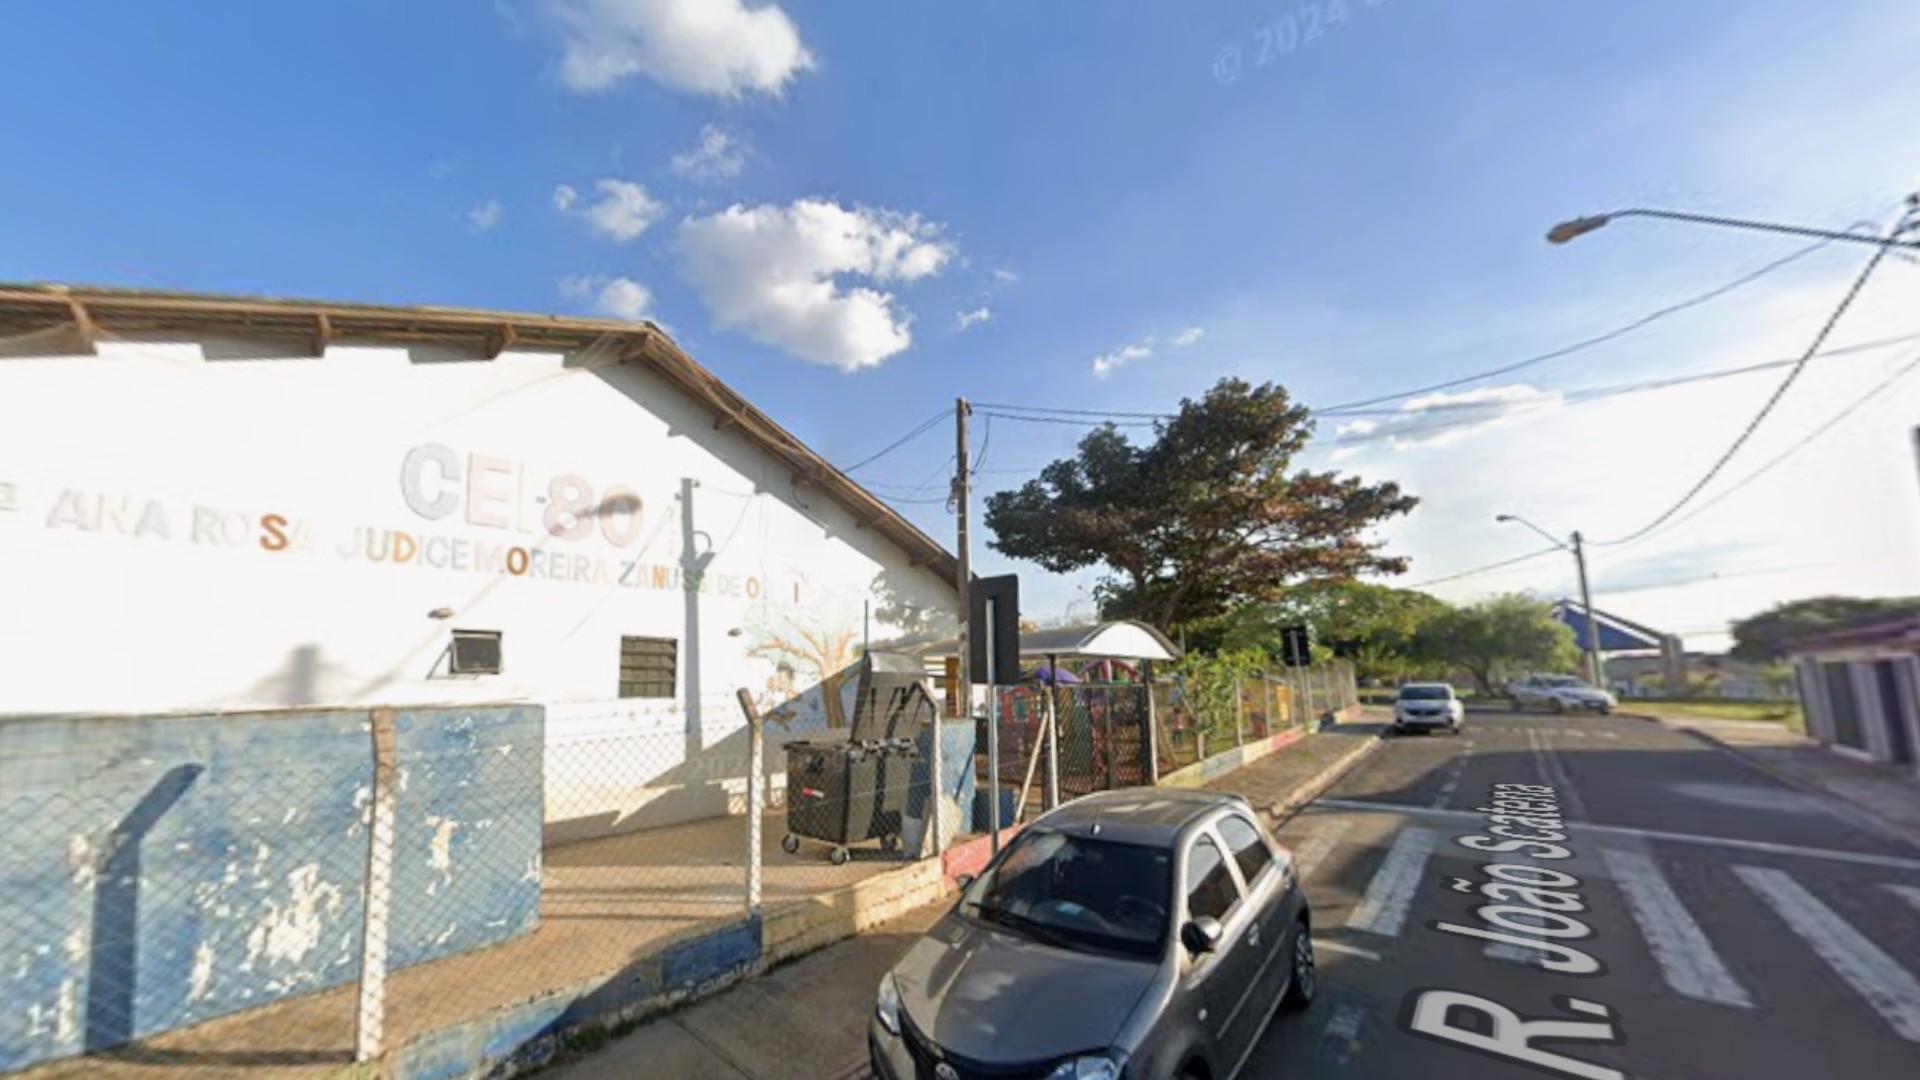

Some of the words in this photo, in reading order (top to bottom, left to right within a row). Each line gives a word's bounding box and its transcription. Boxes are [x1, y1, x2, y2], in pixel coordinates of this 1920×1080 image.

[46, 488, 171, 541] ANA
[190, 504, 317, 555] ROSA
[336, 526, 469, 570] JUDICE
[474, 540, 610, 583] MOREIRA
[718, 573, 741, 598] DE
[400, 442, 643, 547] CEI-80
